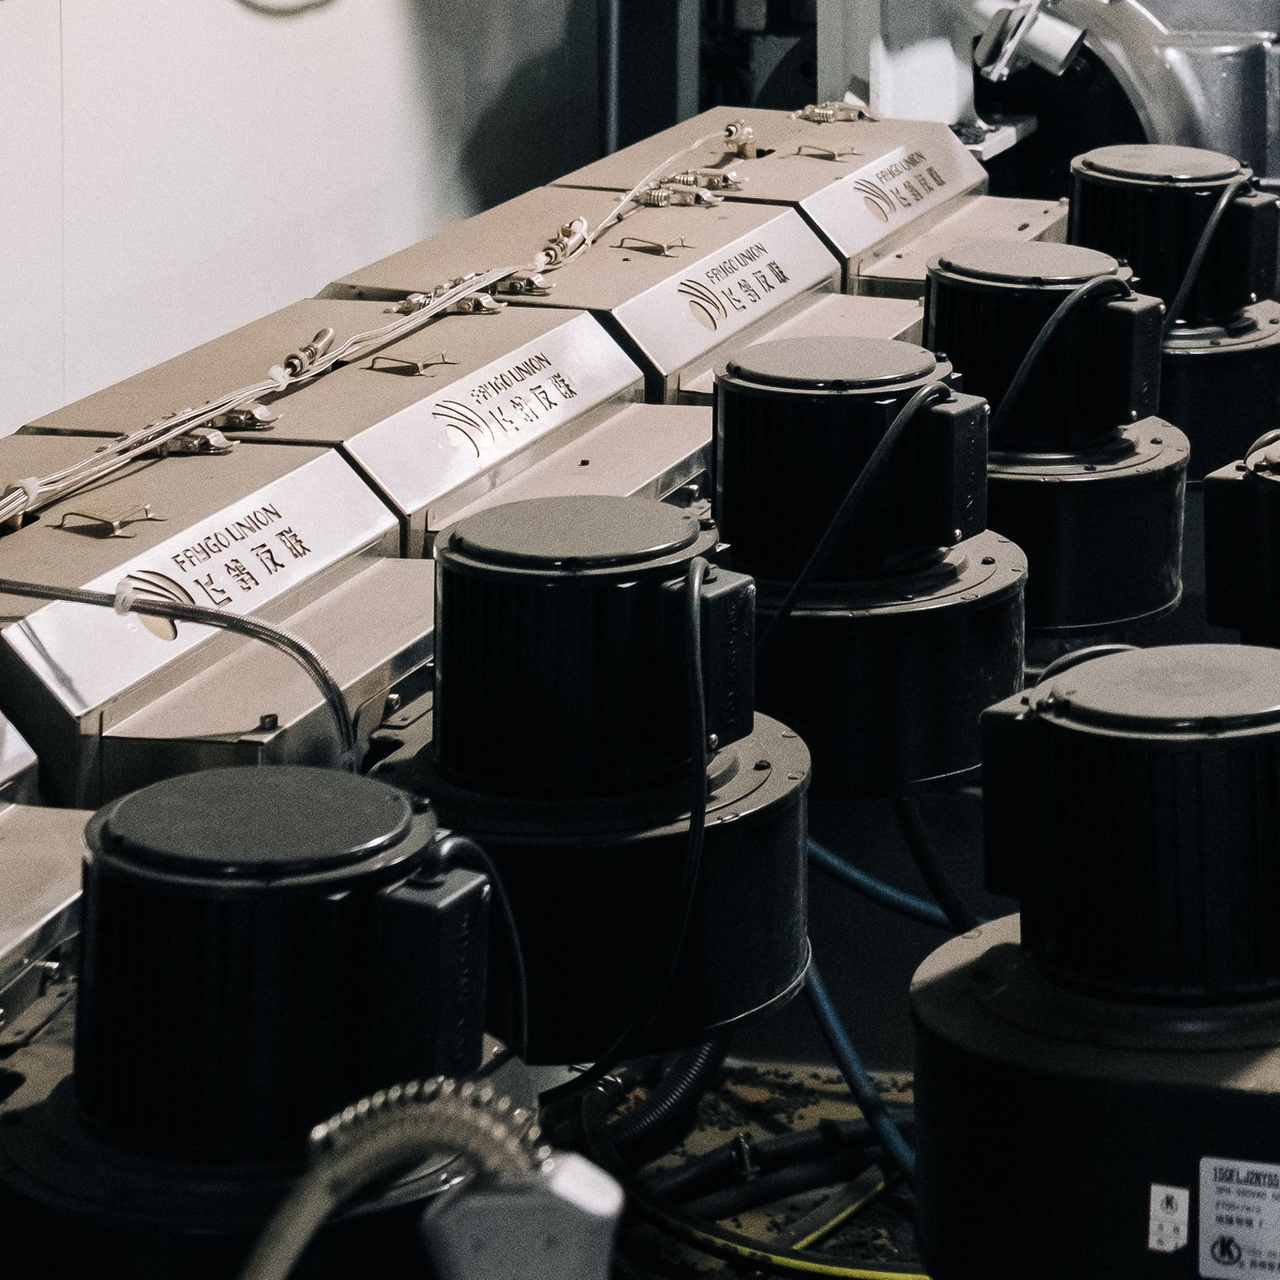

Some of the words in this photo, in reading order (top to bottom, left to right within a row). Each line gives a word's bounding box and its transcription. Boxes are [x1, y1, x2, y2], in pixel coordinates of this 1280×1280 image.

[734, 241, 768, 267] UNION
[508, 351, 552, 382] UNION
[171, 531, 231, 573] FAYGO
[231, 502, 282, 542] UNION
